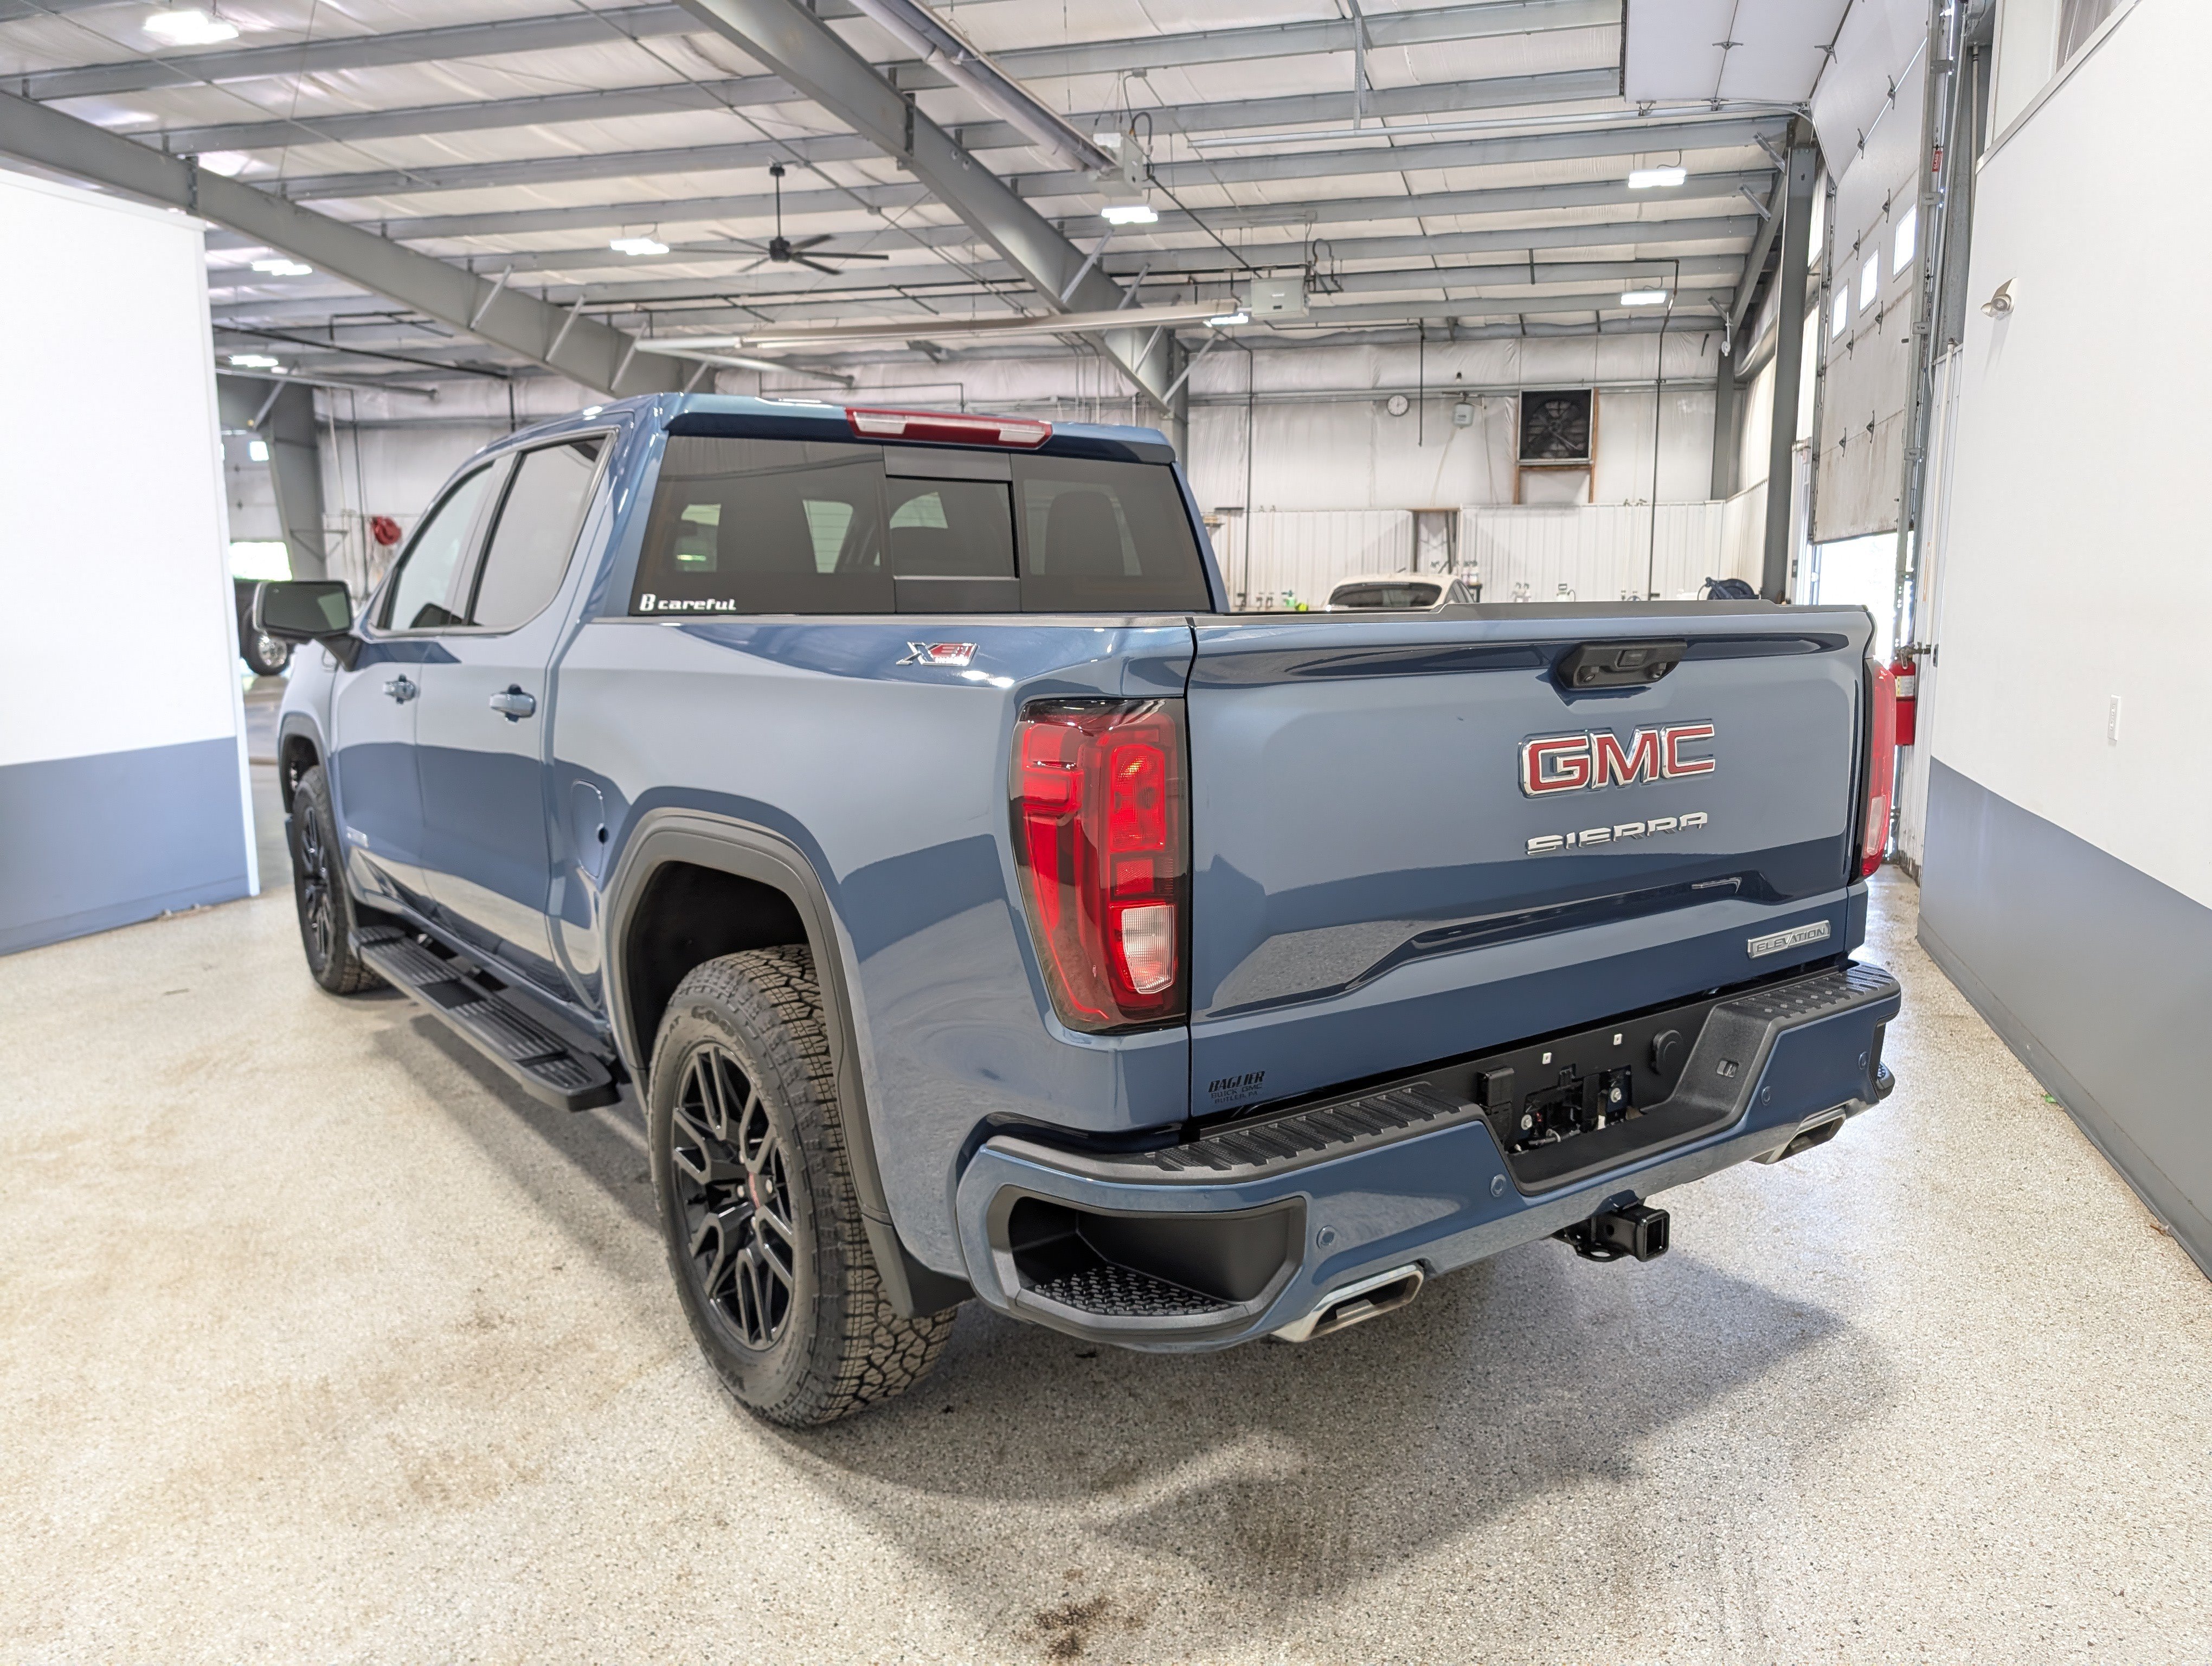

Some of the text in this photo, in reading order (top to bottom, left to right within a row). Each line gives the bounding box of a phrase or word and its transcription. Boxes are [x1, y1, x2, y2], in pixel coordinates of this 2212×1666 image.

[639, 593, 737, 611] B careful
[1520, 722, 1715, 797] GMC
[1525, 811, 1708, 855] SIERRA
[1757, 927, 1825, 952] ELEVATION
[1208, 1071, 1265, 1093] BAGLIER
[1211, 1083, 1263, 1099] BUICK GMC
